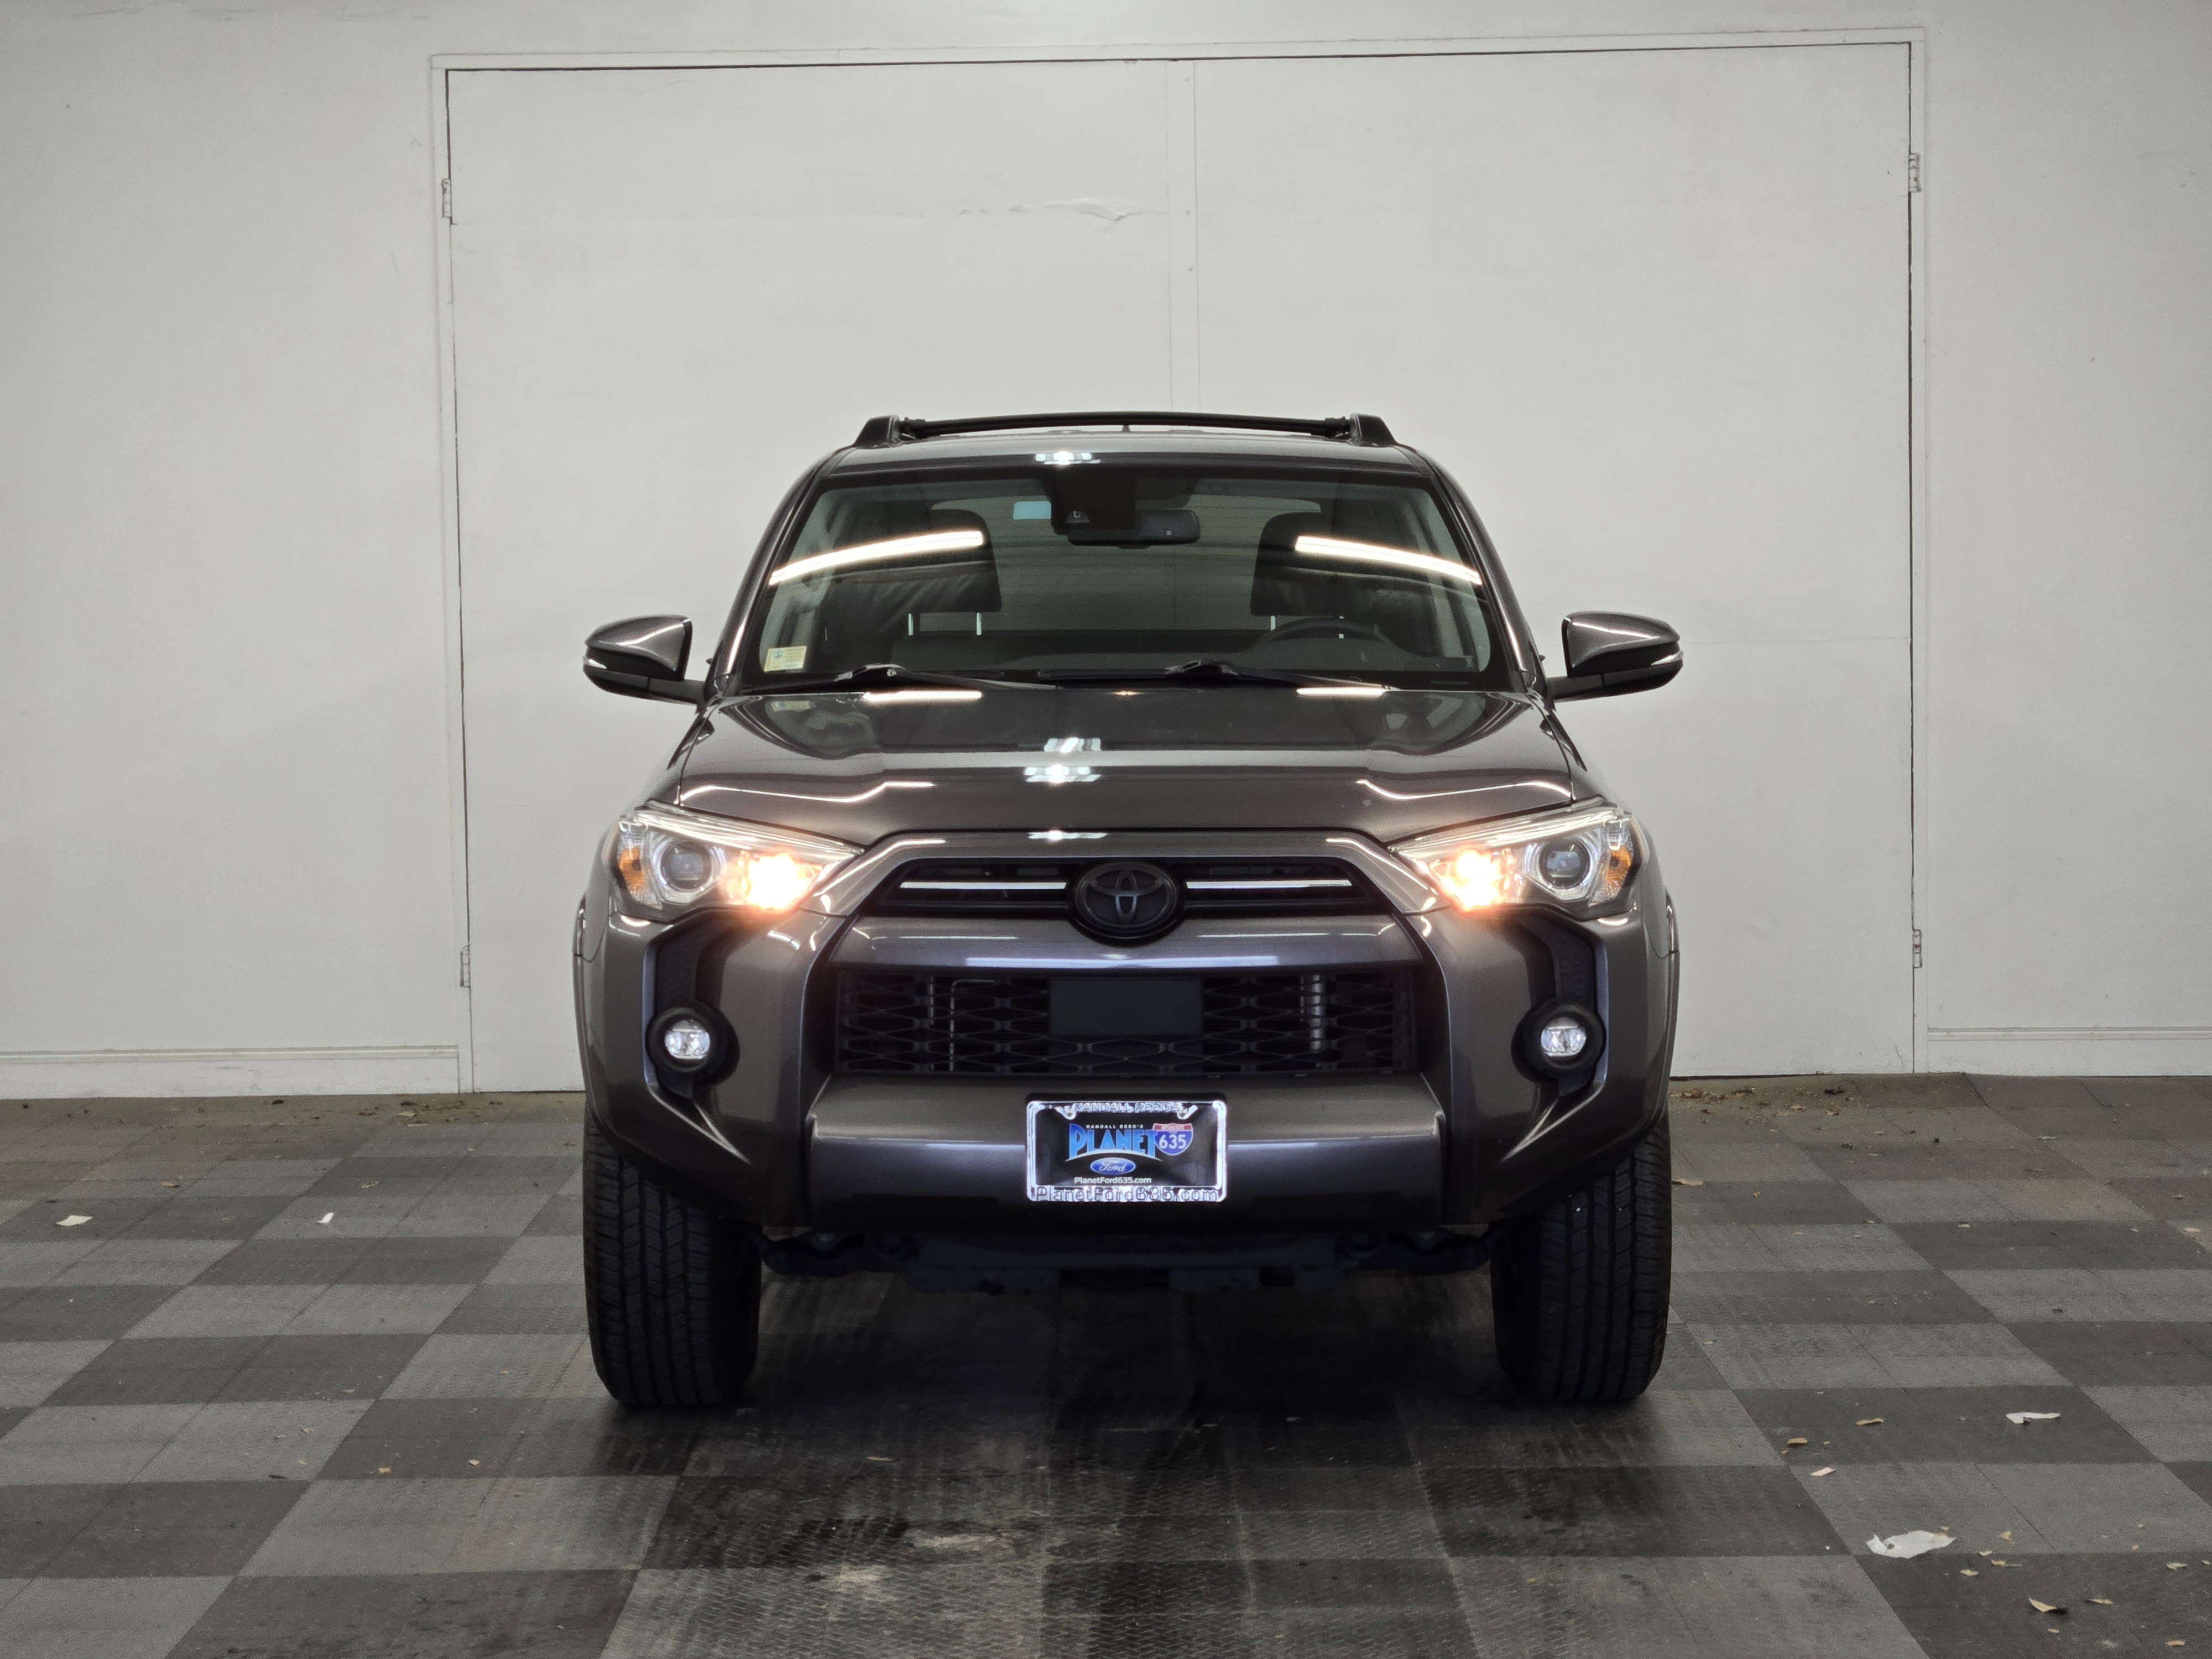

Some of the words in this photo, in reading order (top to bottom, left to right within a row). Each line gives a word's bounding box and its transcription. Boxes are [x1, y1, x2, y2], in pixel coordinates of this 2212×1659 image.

[1069, 1123, 1158, 1160] PLANET
[1159, 1134, 1186, 1149] 635
[1098, 1159, 1126, 1173] Ford
[1036, 1187, 1219, 1202] PlanetFord635.com
